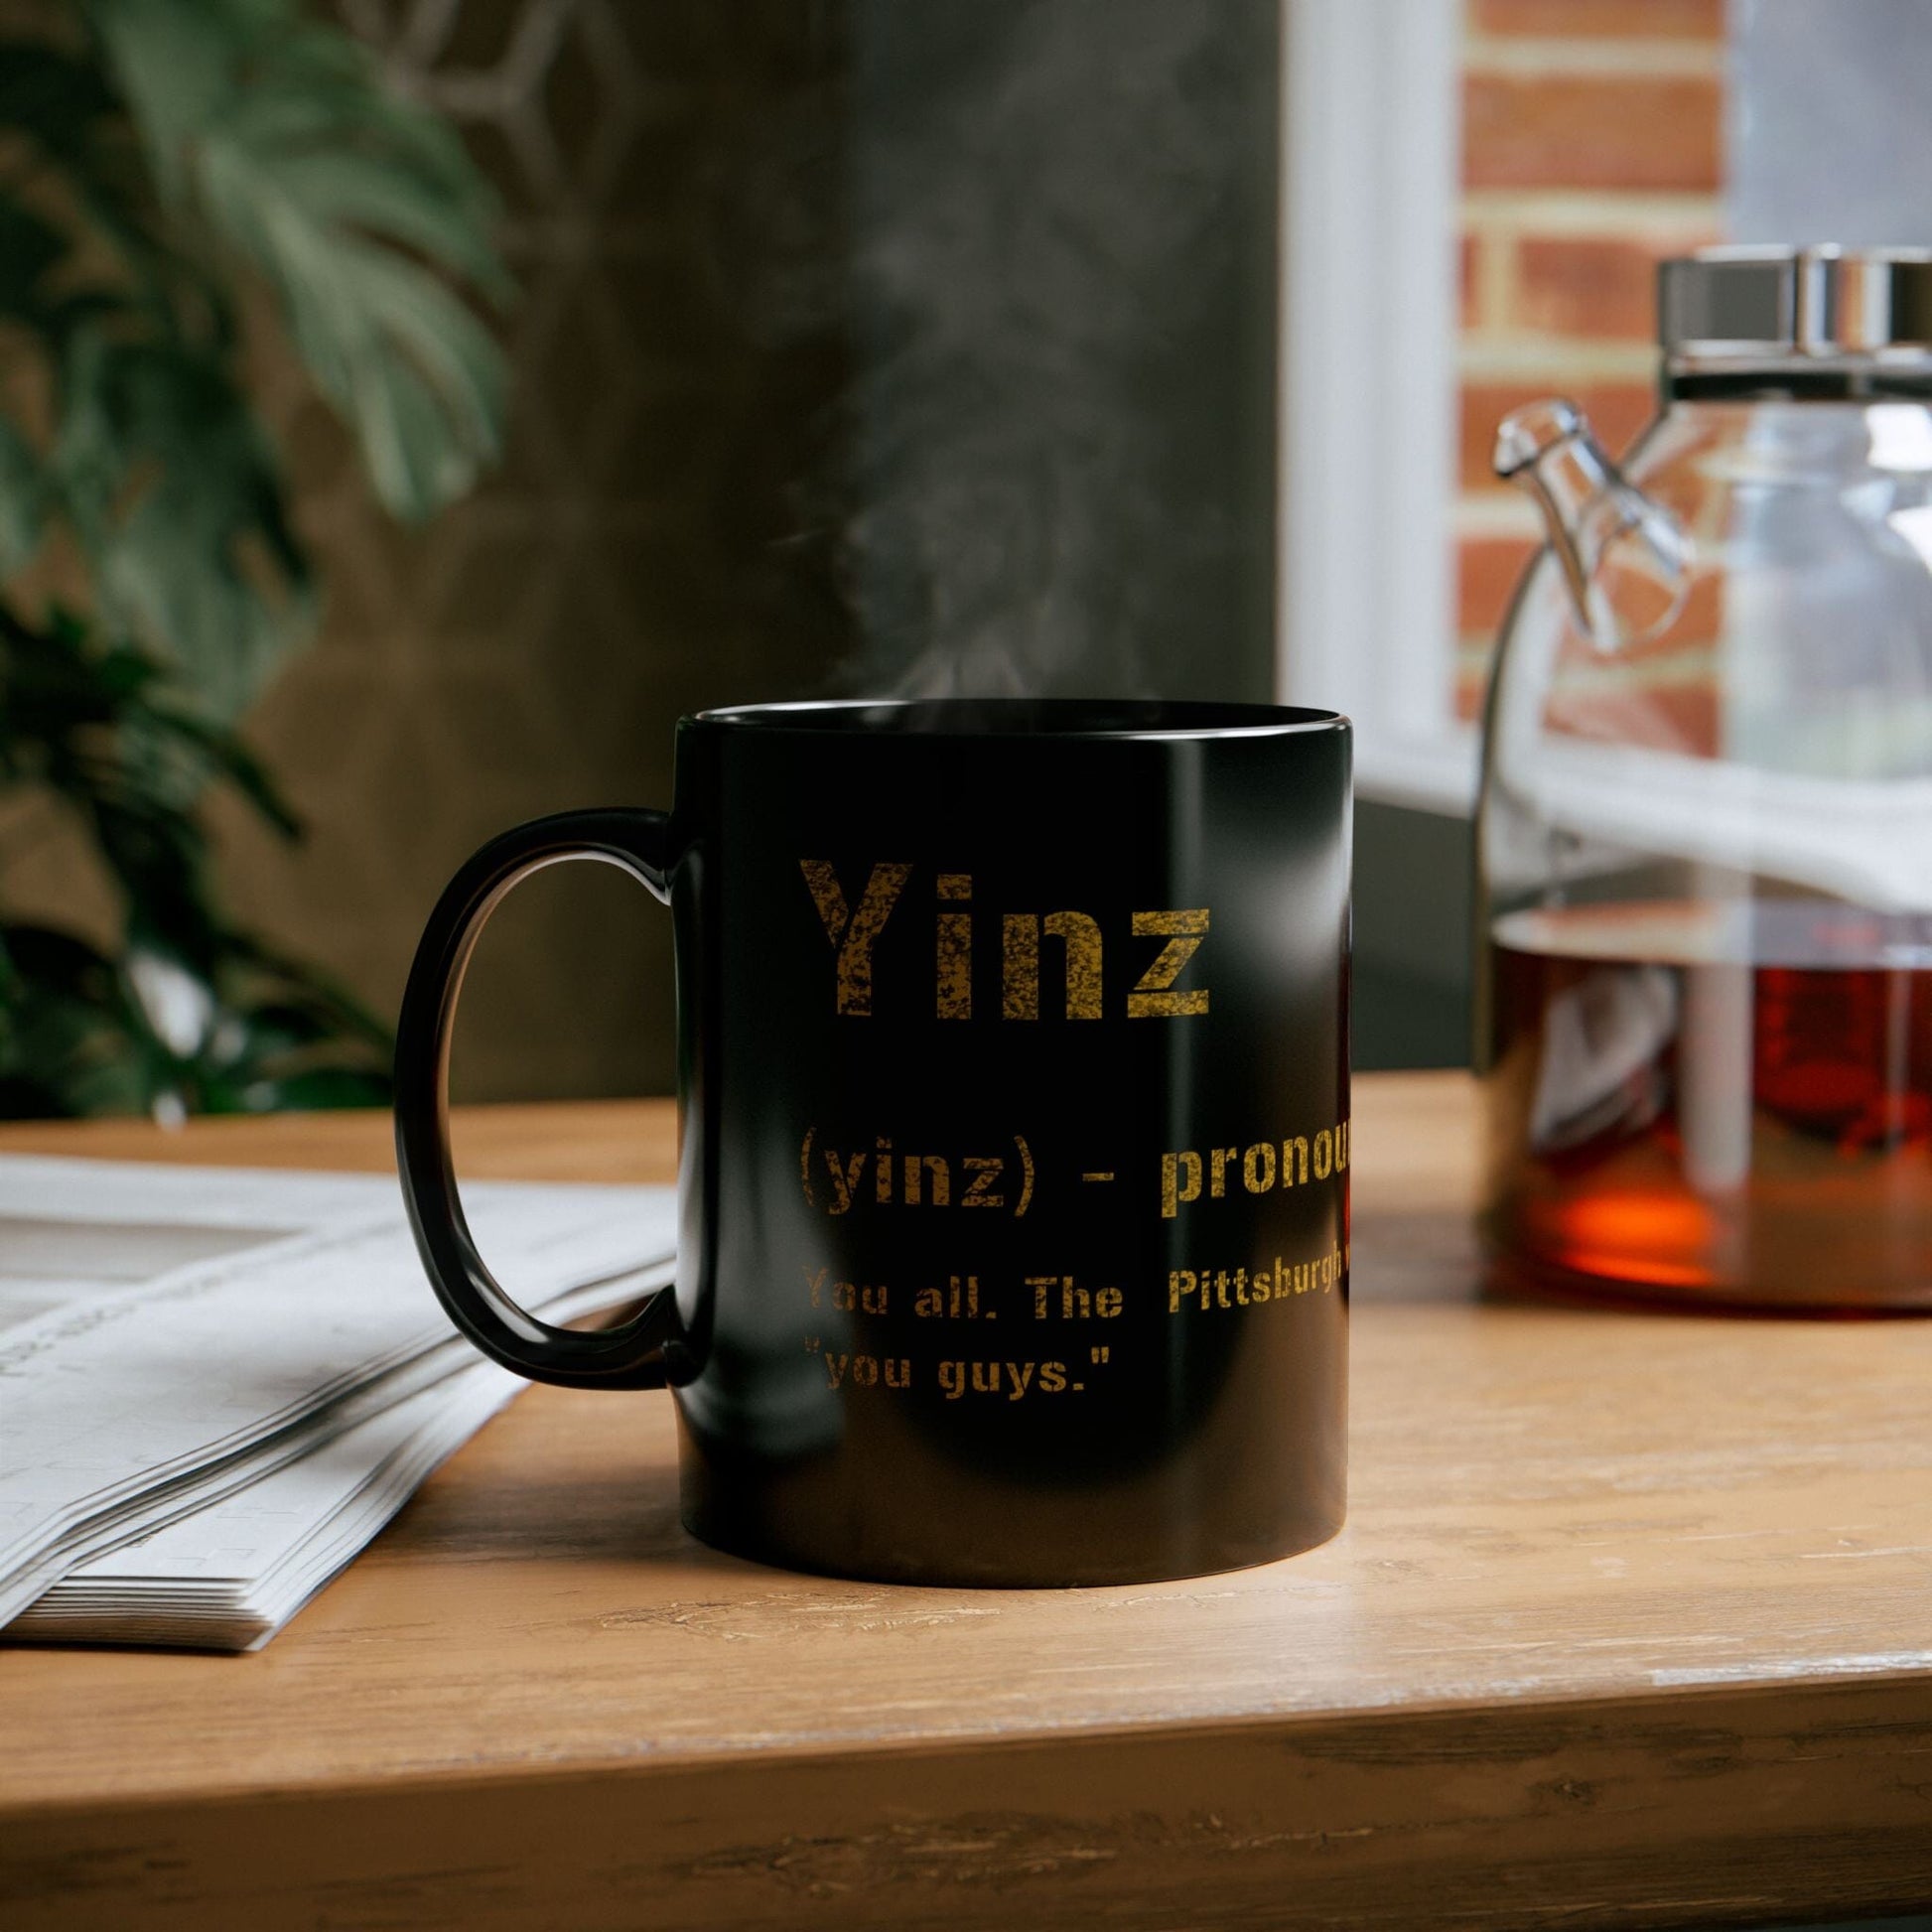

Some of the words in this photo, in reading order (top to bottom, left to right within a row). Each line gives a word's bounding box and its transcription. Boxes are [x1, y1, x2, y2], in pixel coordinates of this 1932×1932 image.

[799, 859, 1209, 1020] Yinz
[800, 1126, 1035, 1217] (yinz)
[802, 1265, 889, 1314] You
[914, 1276, 997, 1318] all.
[1025, 1277, 1123, 1319] The
[1169, 1240, 1341, 1312] Pittsburgh
[804, 1336, 910, 1390] "you
[938, 1346, 1110, 1401] guys."
